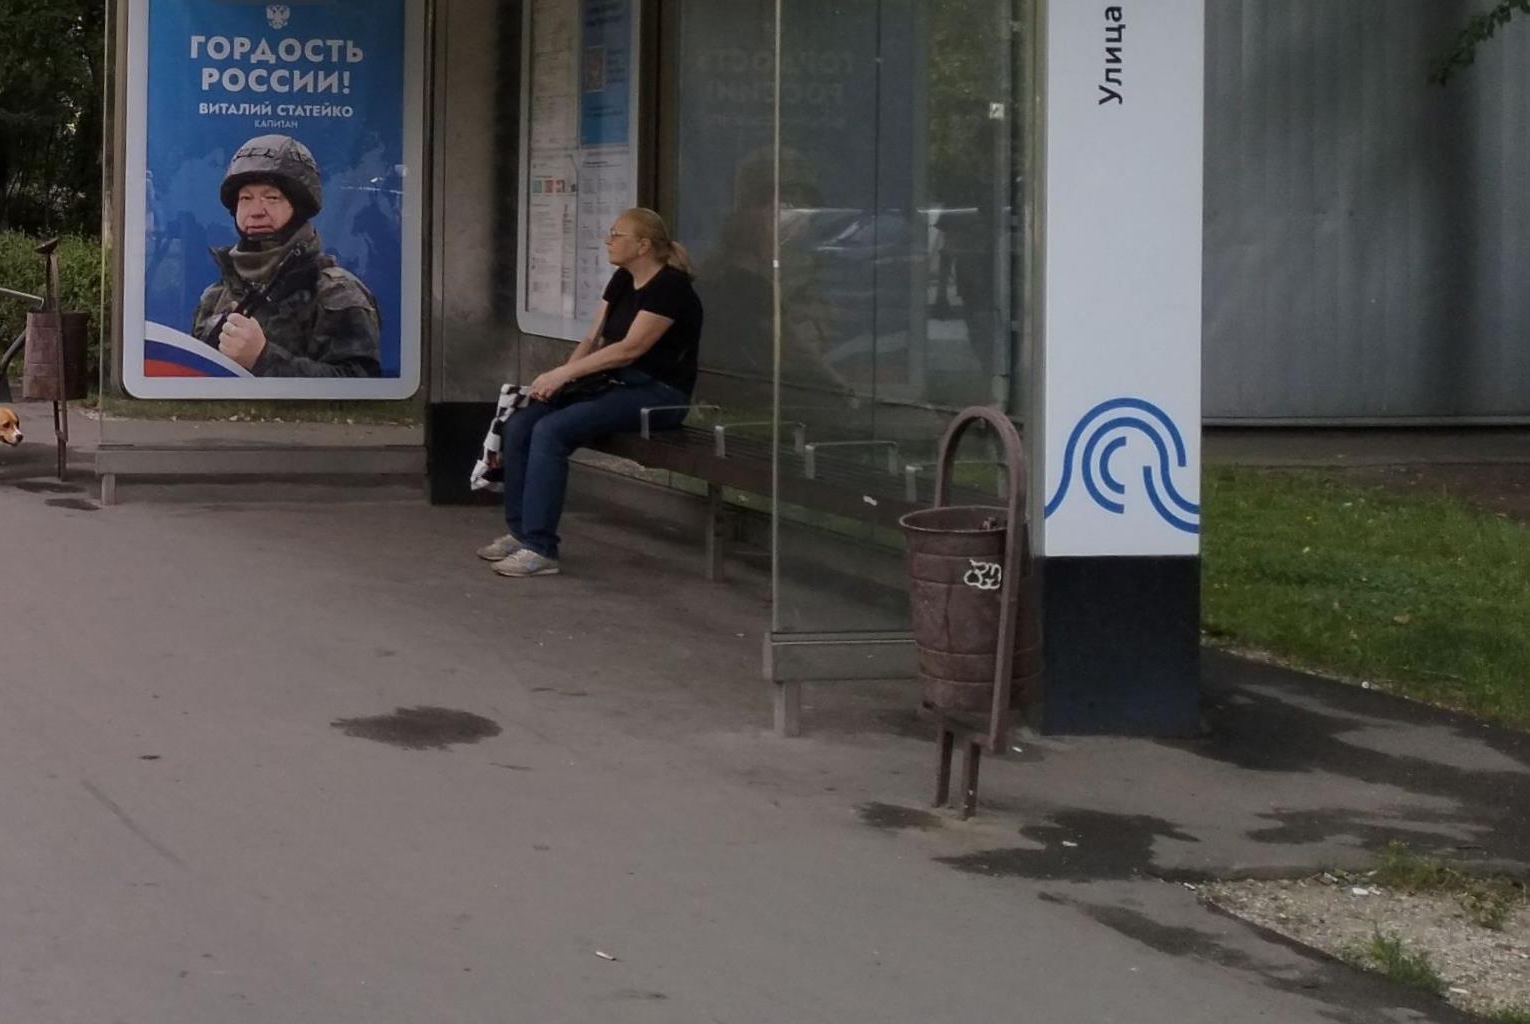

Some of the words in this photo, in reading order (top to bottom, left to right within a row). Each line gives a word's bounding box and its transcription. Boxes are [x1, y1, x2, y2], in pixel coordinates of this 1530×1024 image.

[190, 35, 364, 64] ГОРДОСТЬ
[1098, 6, 1126, 105] Улица
[201, 67, 351, 95] РОССИИ!
[198, 101, 271, 116] ВИТАЛИЙ
[276, 102, 354, 118] СТАТЕЙКО
[254, 119, 298, 129] КАПИТАН
